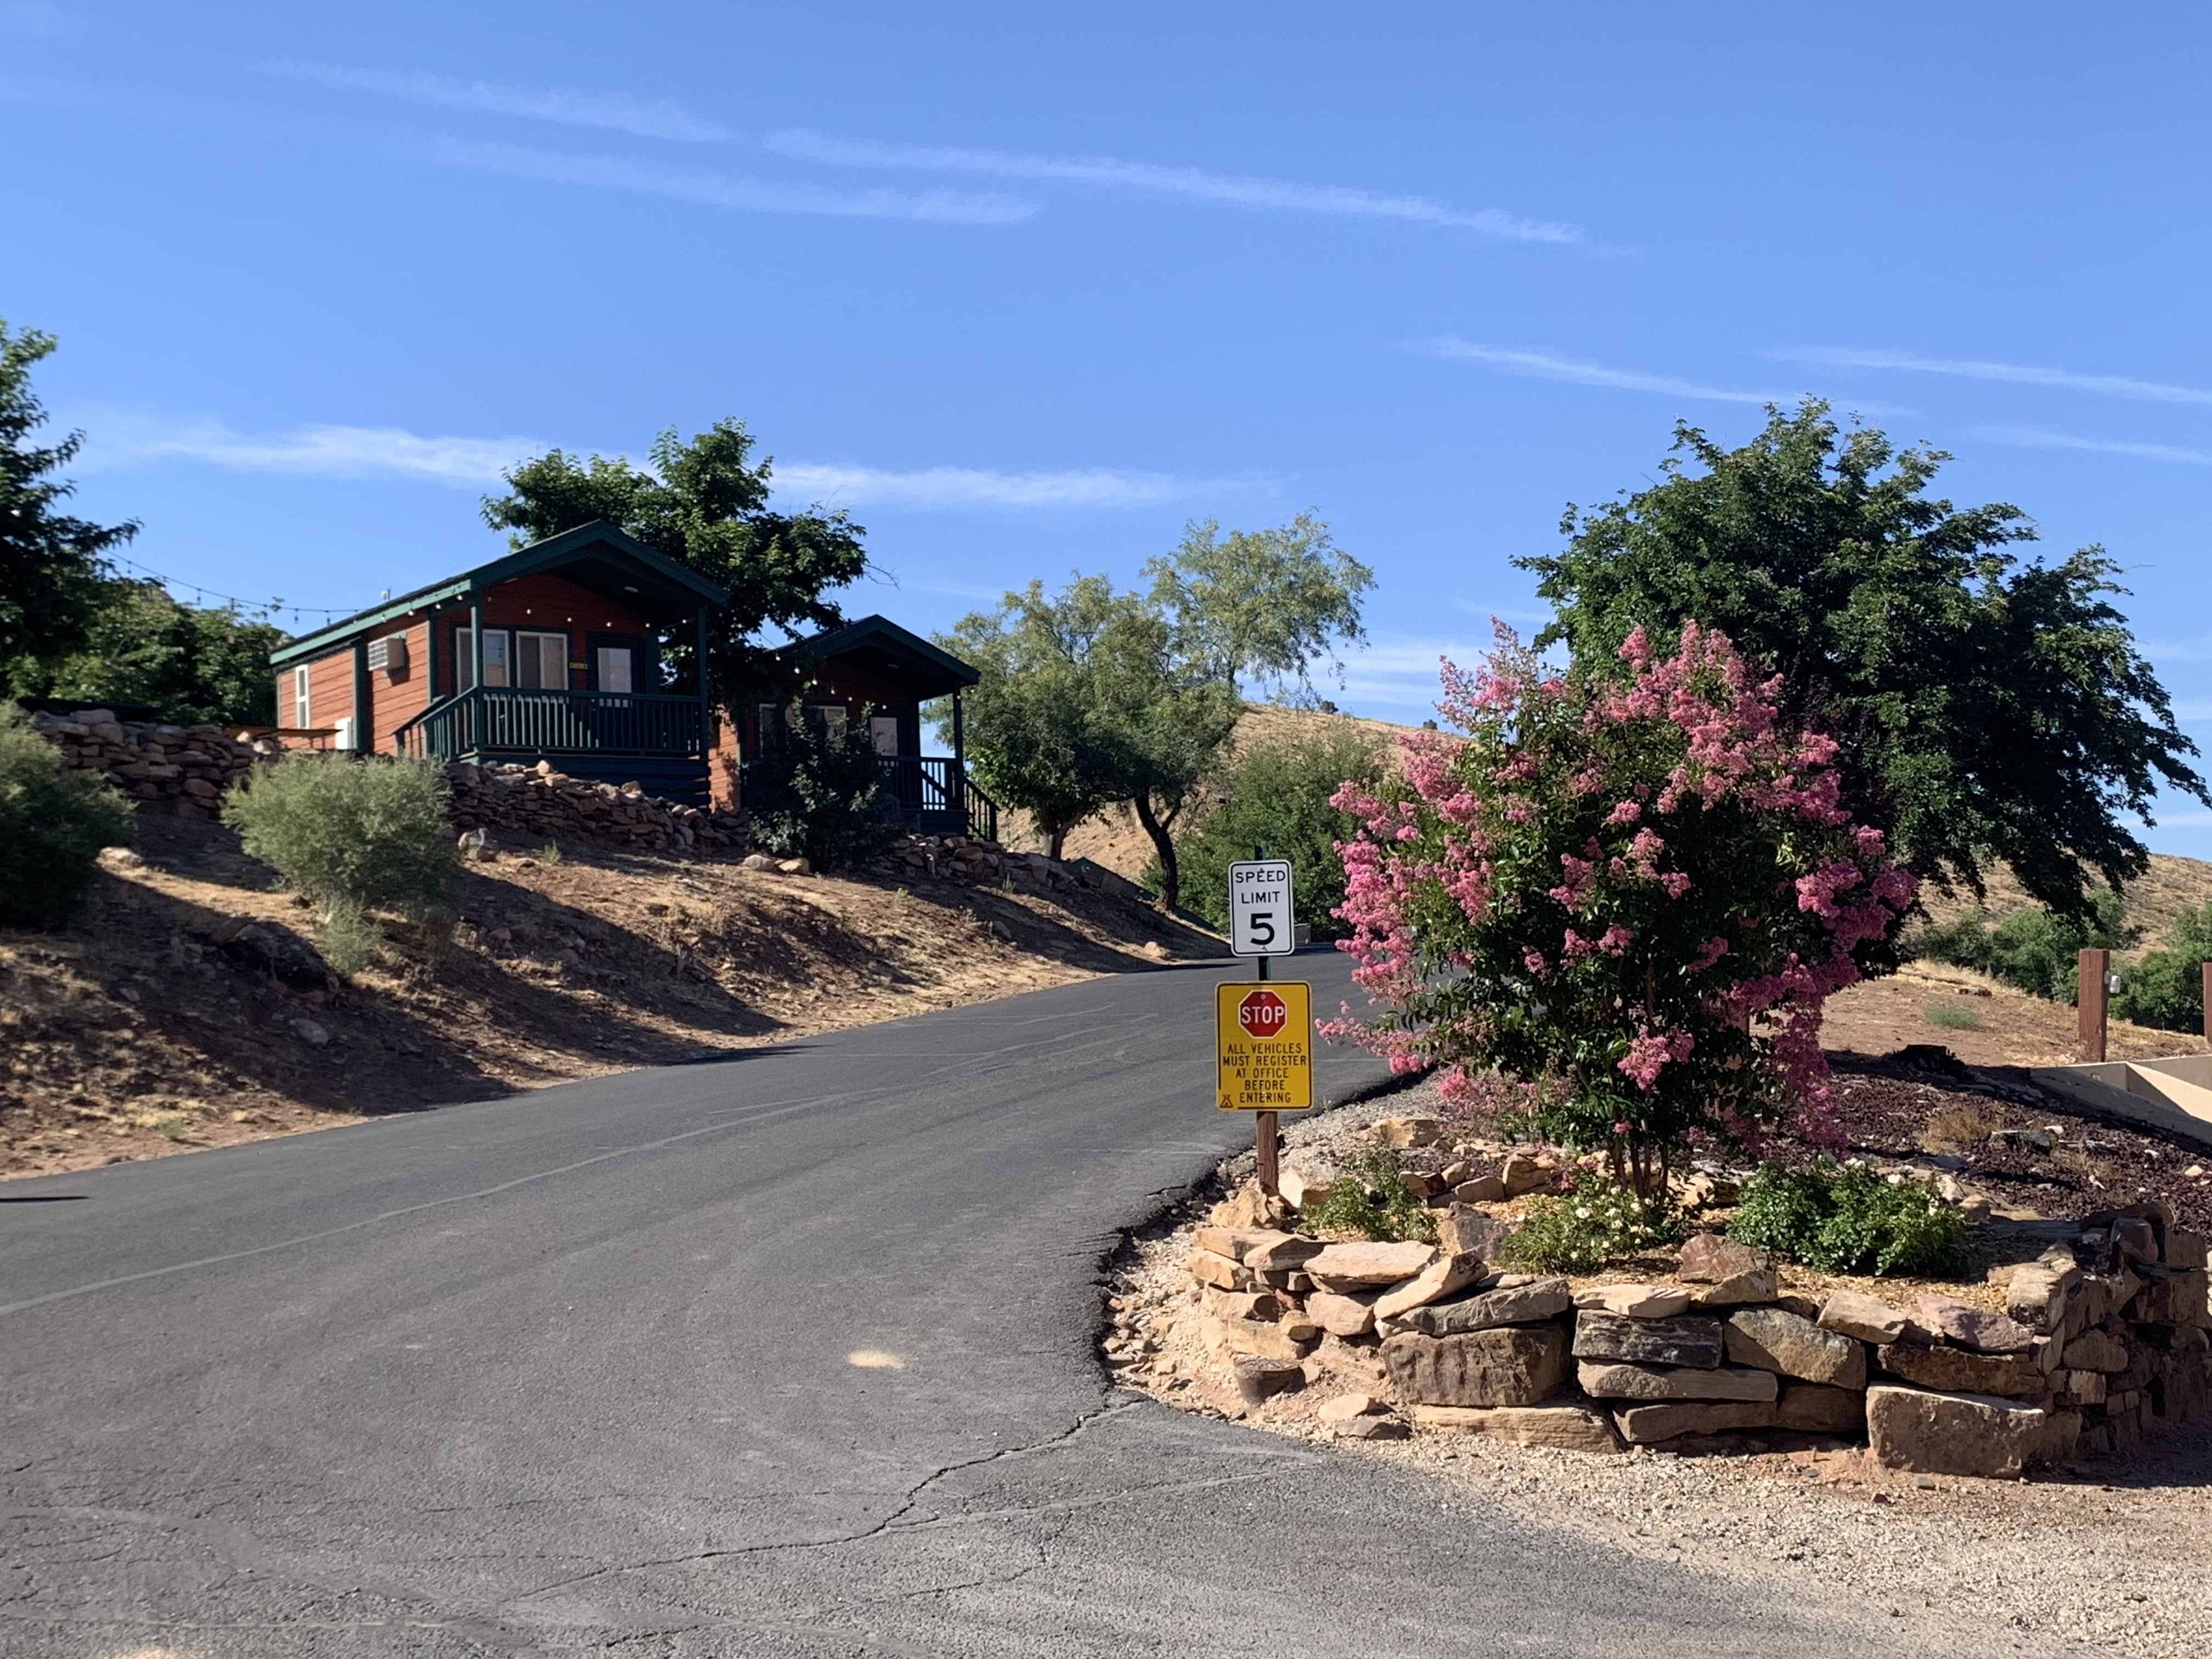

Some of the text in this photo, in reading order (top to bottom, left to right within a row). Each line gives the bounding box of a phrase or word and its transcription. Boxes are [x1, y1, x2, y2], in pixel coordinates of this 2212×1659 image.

[1235, 870, 1286, 883] SPEED
[1241, 891, 1280, 904] LIMIT
[1250, 912, 1275, 946] 5
[1242, 1005, 1284, 1024] STOP
[1227, 1043, 1302, 1054] ALL VEHICLES
[1223, 1055, 1306, 1066] MUST REGISTER
[1235, 1067, 1289, 1078] AT OFFICE
[1245, 1080, 1285, 1091] BEFORE
[1239, 1092, 1291, 1103] ENTERING
